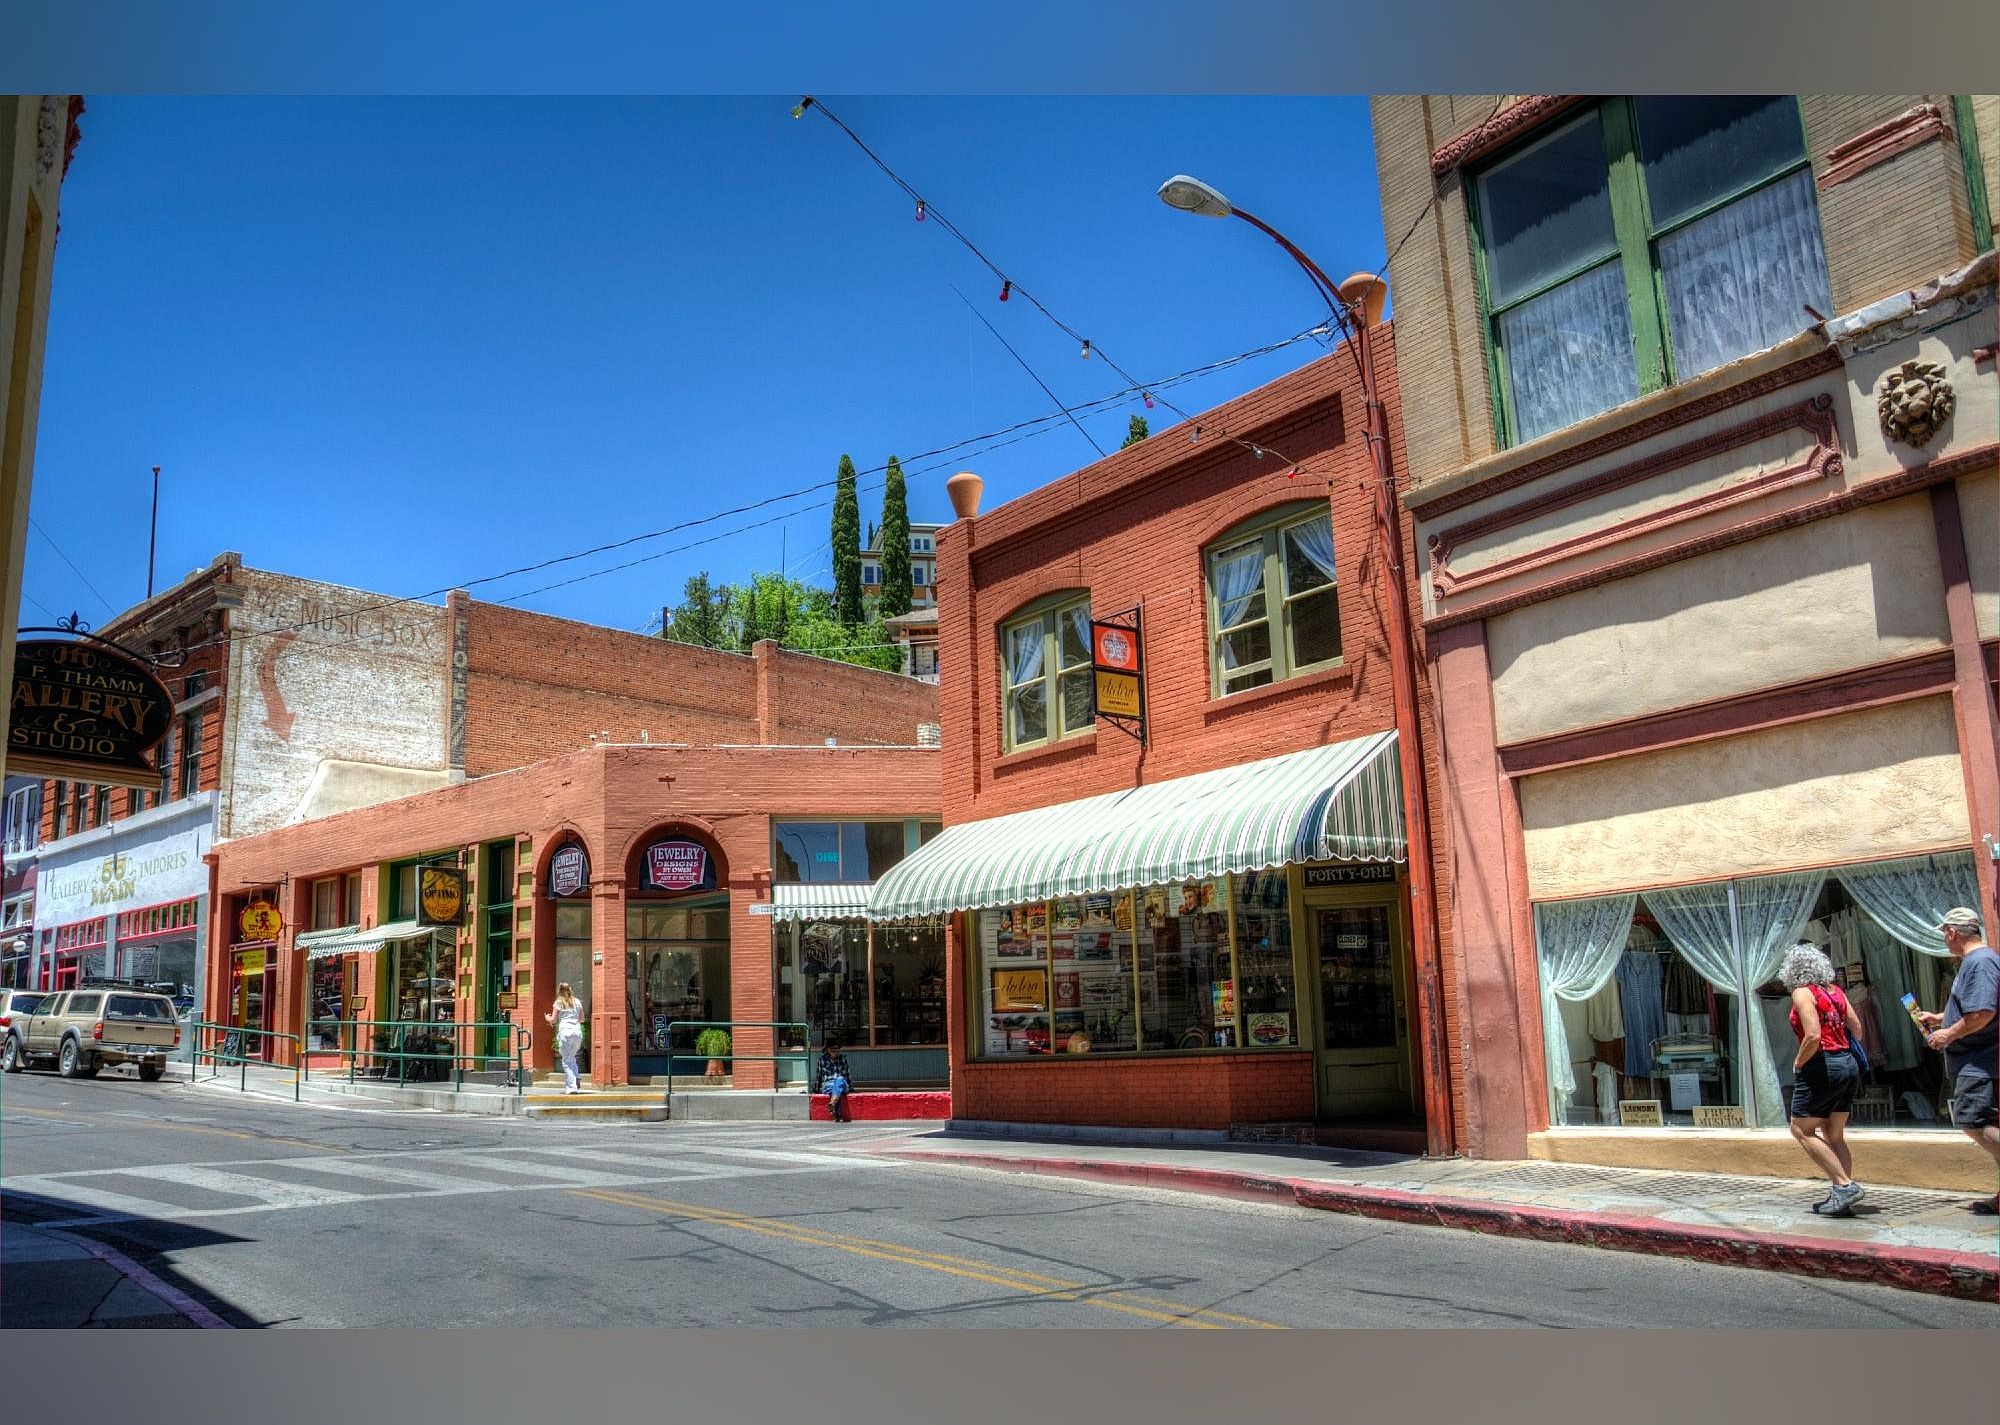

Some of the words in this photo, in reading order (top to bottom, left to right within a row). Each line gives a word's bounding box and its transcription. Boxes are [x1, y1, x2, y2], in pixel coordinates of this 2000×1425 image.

[62, 669, 145, 694] THAMM
[13, 680, 157, 736] ALLERY
[12, 728, 115, 755] STUDIO
[137, 850, 188, 878] IMPORTS
[654, 847, 700, 863] JEWELRY
[1308, 865, 1392, 882] FORTY-ONE
[51, 878, 88, 900] GALLERY
[1624, 1105, 1656, 1113] LAUNDRY
[1703, 1107, 1735, 1118] FREE
[1699, 1118, 1745, 1127] MUSEUM
